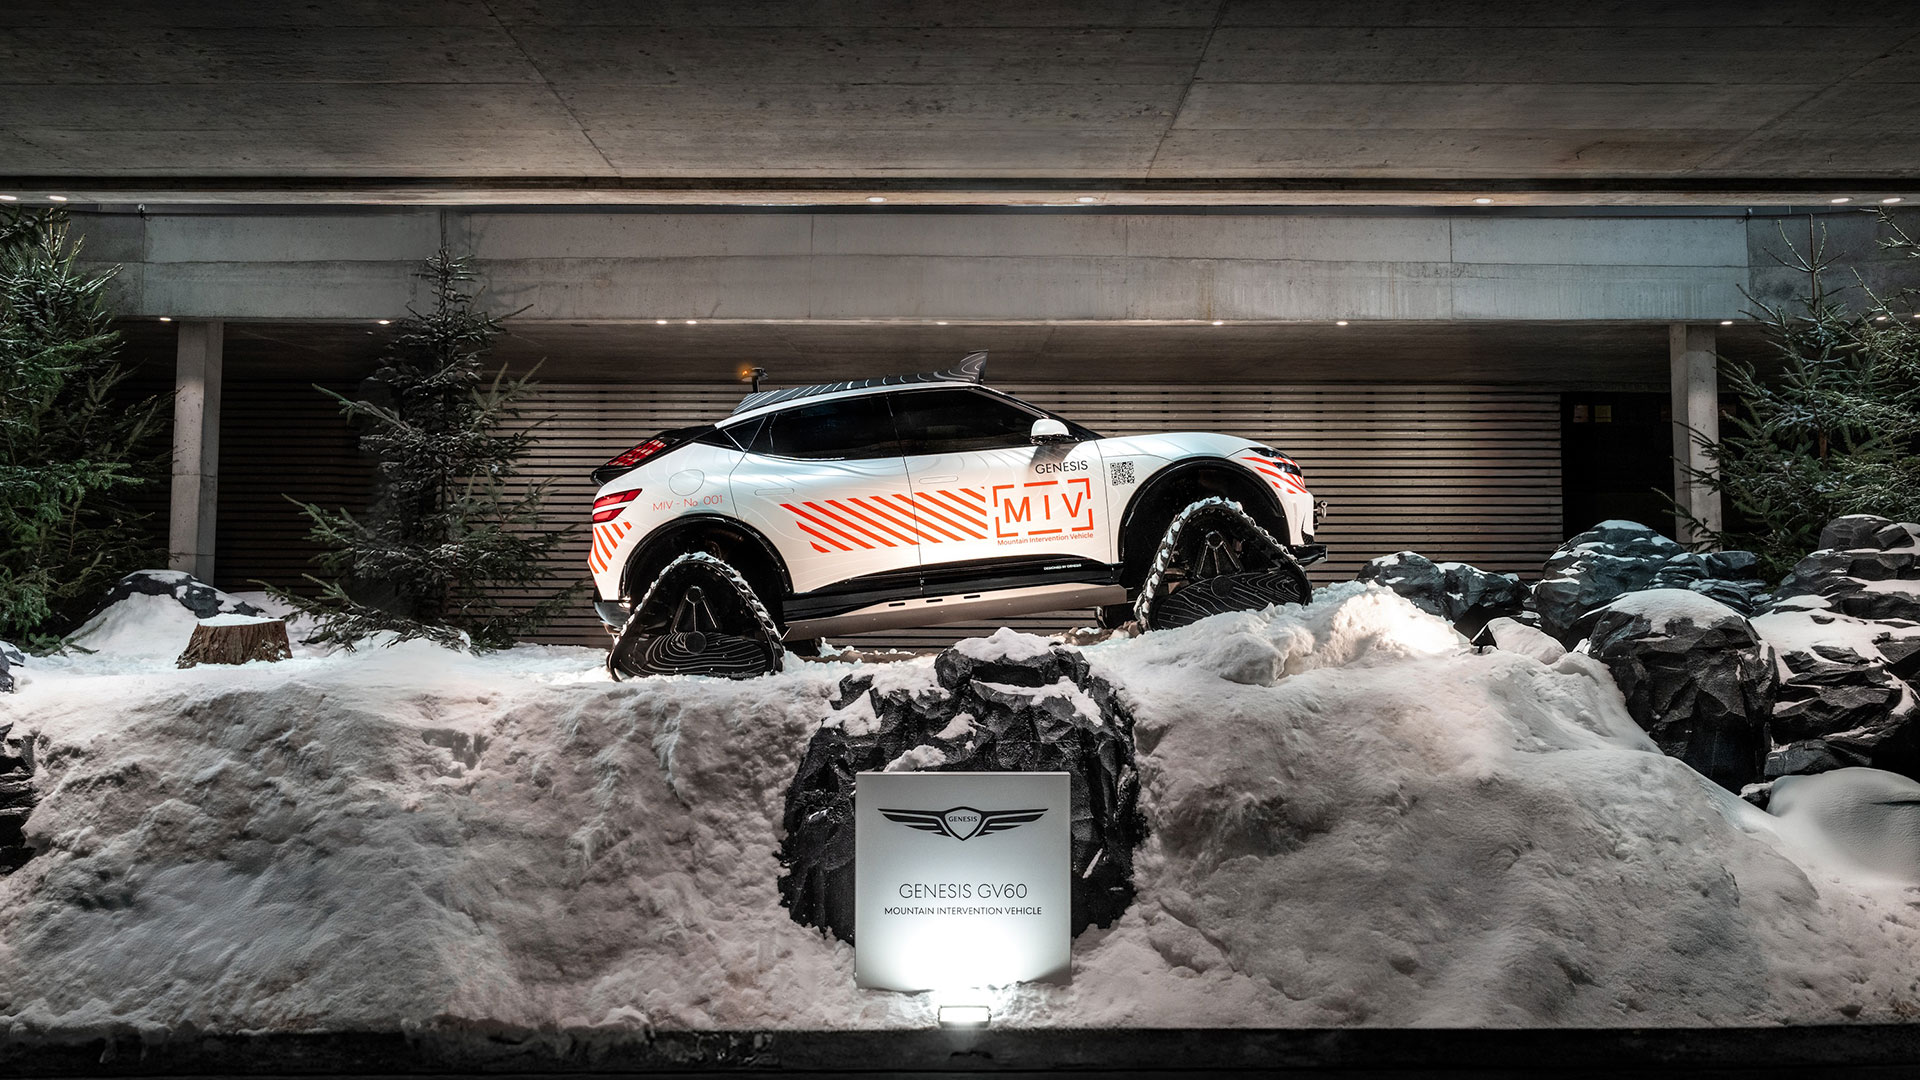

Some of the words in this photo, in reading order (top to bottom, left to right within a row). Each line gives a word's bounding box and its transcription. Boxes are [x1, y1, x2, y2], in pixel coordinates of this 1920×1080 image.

[1035, 460, 1089, 475] GENESIS
[653, 500, 673, 512] MIV
[703, 494, 723, 505] 001
[997, 538, 1028, 546] Mountain
[1029, 534, 1069, 543] Intervention
[1070, 532, 1094, 540] Vehicle
[899, 883, 972, 899] GENESIS
[977, 883, 1028, 899] GV60
[884, 906, 935, 916] MOUNTAIN
[936, 906, 1003, 916] INTERVENTION
[1005, 906, 1042, 916] VEHICLE
